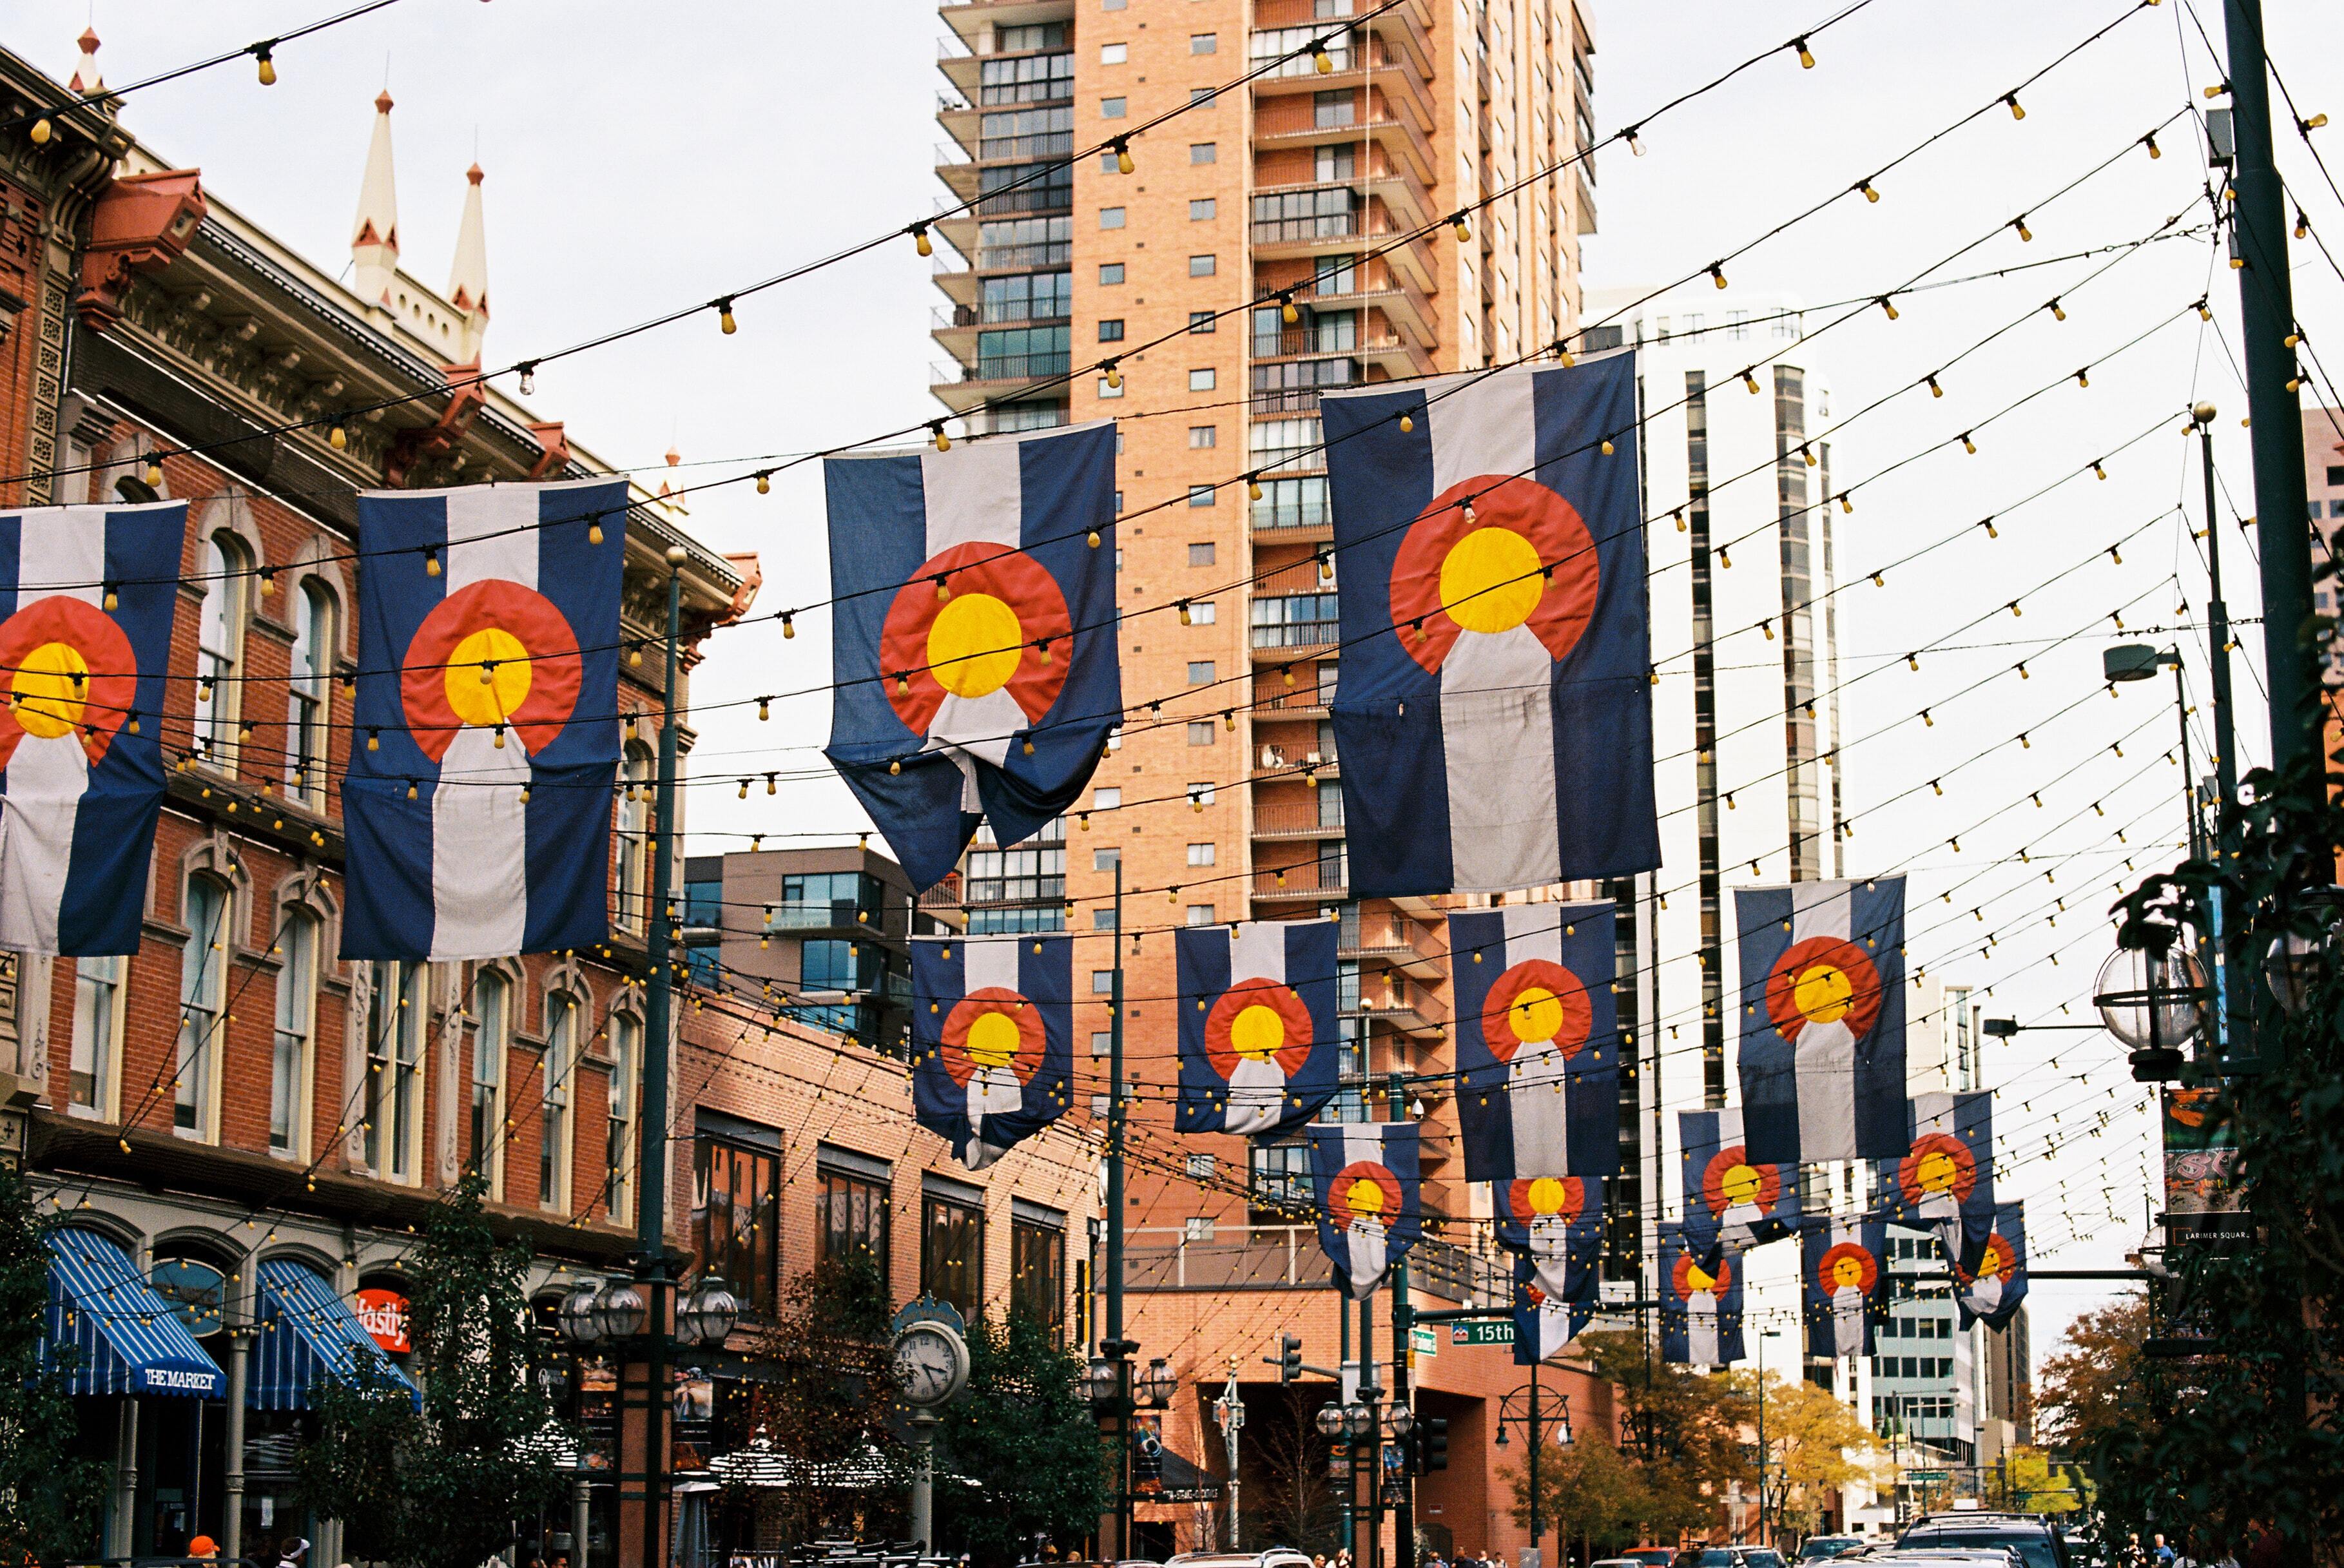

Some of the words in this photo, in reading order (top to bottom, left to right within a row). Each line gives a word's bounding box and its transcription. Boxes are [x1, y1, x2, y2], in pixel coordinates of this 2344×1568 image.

[2185, 1232, 2217, 1240] LARIMER
[1477, 1324, 1514, 1341] 15th
[145, 1368, 167, 1386] THE
[167, 1371, 216, 1389] MARKET
